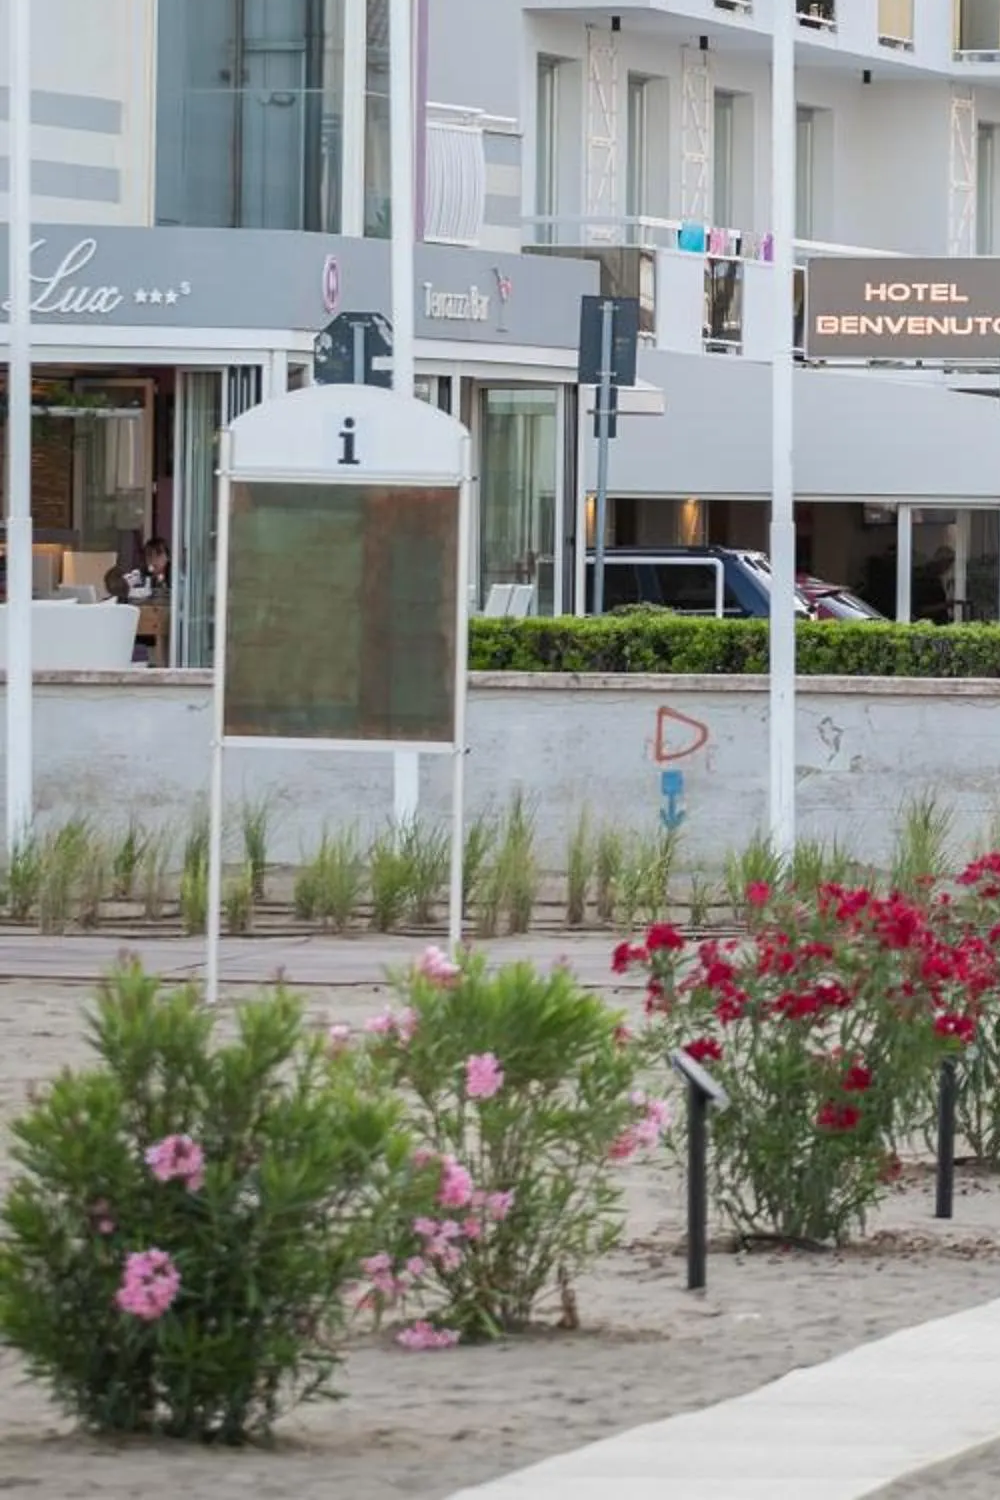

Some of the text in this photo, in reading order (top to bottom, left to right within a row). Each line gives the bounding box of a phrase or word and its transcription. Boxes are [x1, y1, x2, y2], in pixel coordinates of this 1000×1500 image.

[2, 238, 124, 313] Lux
[865, 282, 969, 302] HOTEL
[470, 284, 490, 320] Bar
[337, 416, 361, 465] i
[655, 705, 709, 764] D
